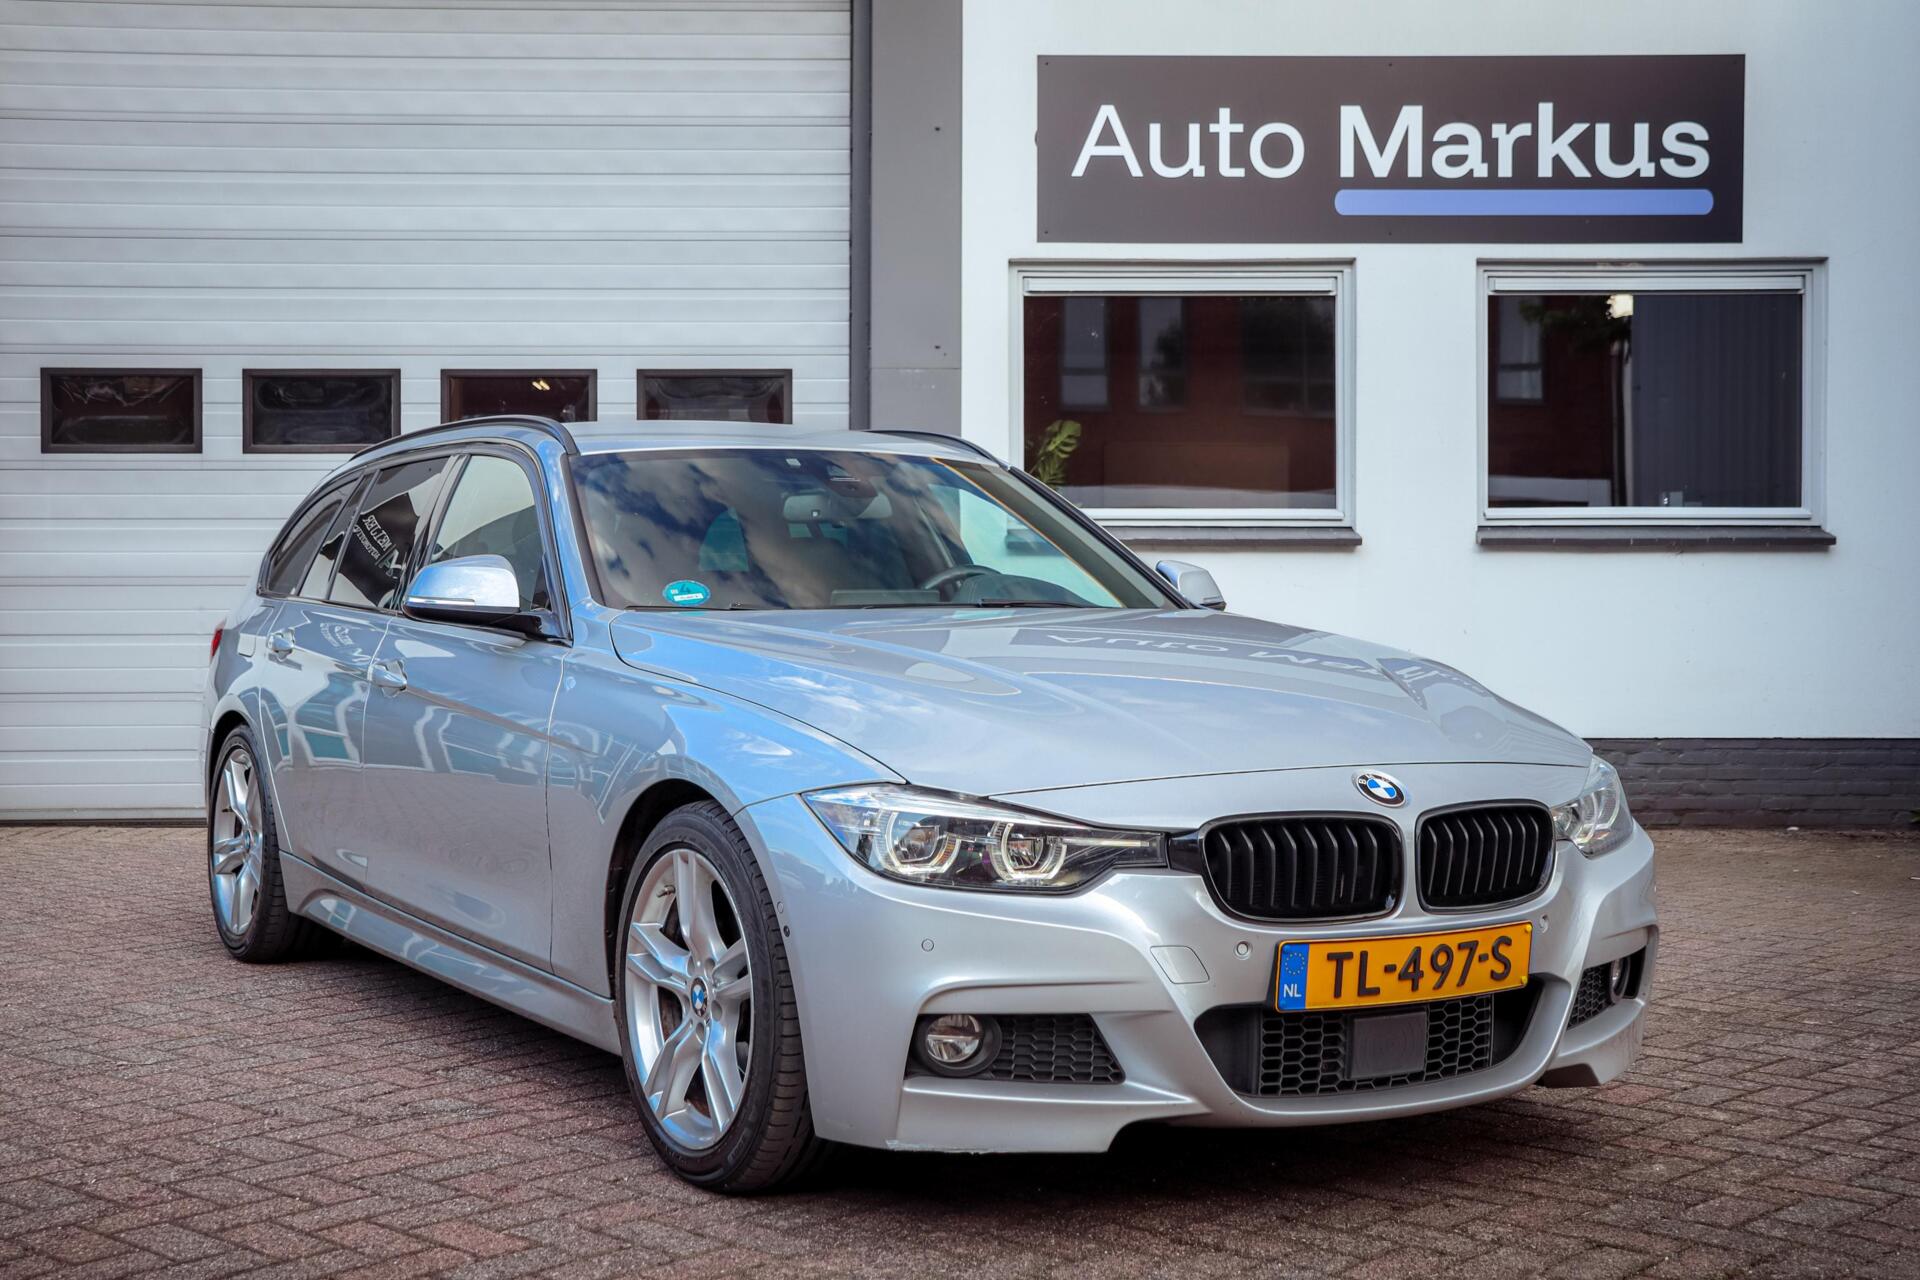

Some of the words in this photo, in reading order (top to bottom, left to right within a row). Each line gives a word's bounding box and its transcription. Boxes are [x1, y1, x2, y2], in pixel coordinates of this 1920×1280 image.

[1071, 104, 1305, 178] Auto
[1340, 102, 1710, 178] Markus
[1283, 983, 1302, 998] NL
[1327, 936, 1513, 998] TL-497-S
